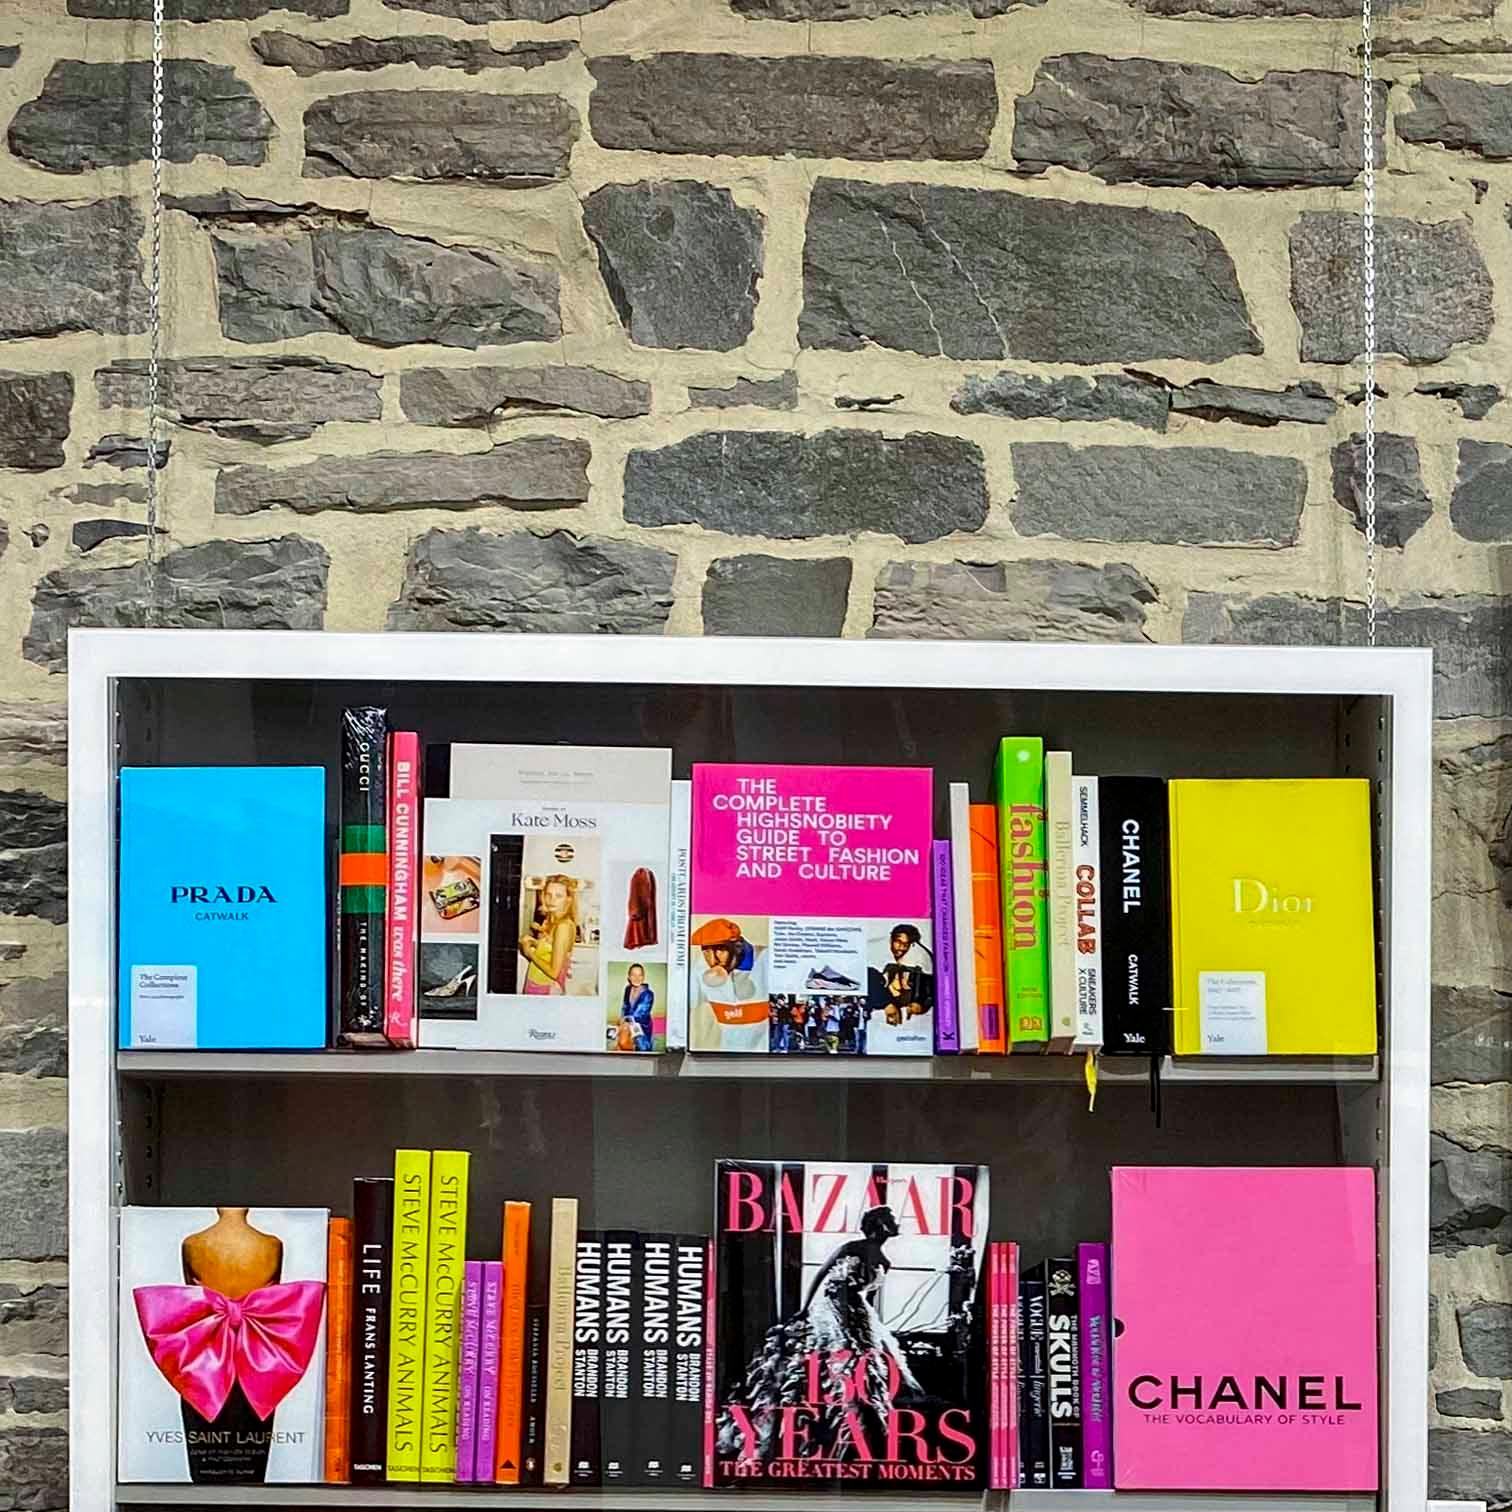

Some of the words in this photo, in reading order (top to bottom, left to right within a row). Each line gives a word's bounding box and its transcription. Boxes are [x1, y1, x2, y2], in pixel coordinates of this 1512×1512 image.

[397, 761, 411, 799] BILL
[712, 795, 827, 812] COMPLETE
[736, 778, 777, 795] THE
[512, 813, 550, 828] Kate
[554, 814, 597, 828] Moss
[736, 813, 892, 831] HIGHSNOBIETY
[736, 830, 799, 846] GUIDE
[817, 831, 847, 846] TO
[1079, 786, 1089, 847] SEMMELHACK
[395, 803, 410, 921] CUNNINGHAM
[736, 846, 811, 862] STREET
[829, 848, 919, 865] FASHION
[736, 863, 782, 879] AND
[799, 864, 891, 881] CULTURE
[1009, 802, 1048, 950] fashion
[1122, 818, 1141, 914] CHANEL
[171, 886, 278, 903] PRADA
[195, 912, 249, 921] CATWALK
[1076, 864, 1096, 956] COLLAB
[1232, 879, 1314, 914] Dior
[1128, 954, 1138, 1006] CATWALK
[1123, 1032, 1146, 1044] Yale
[402, 1174, 422, 1235] STEVE
[722, 1171, 977, 1240] BAZAAR
[362, 1244, 382, 1295] LIFE
[574, 1242, 601, 1344] HUMANS
[605, 1242, 631, 1344] HUMANS
[643, 1242, 670, 1345] HUMANS
[676, 1246, 703, 1348] HUMANS
[364, 1308, 376, 1351] FRANS
[363, 1354, 375, 1414] LANTING
[574, 1349, 585, 1397] STANTON
[587, 1349, 599, 1398] BRANDON
[1049, 1314, 1072, 1419] SKULLS
[395, 1352, 414, 1452] ANIMALS
[1127, 1374, 1363, 1411] CHANEL
[146, 1431, 182, 1444] YVES
[187, 1431, 229, 1444] SAINT
[236, 1431, 305, 1444] LAURENT
[716, 1404, 976, 1464] YEARS
[1143, 1414, 1169, 1424] THE
[1175, 1414, 1272, 1425] VOCABULARY
[1278, 1415, 1297, 1425] OF
[1302, 1415, 1345, 1425] STYLE
[719, 1461, 763, 1478] THE
[768, 1461, 873, 1479] GREATEST
[878, 1464, 976, 1481] MOMENTS
